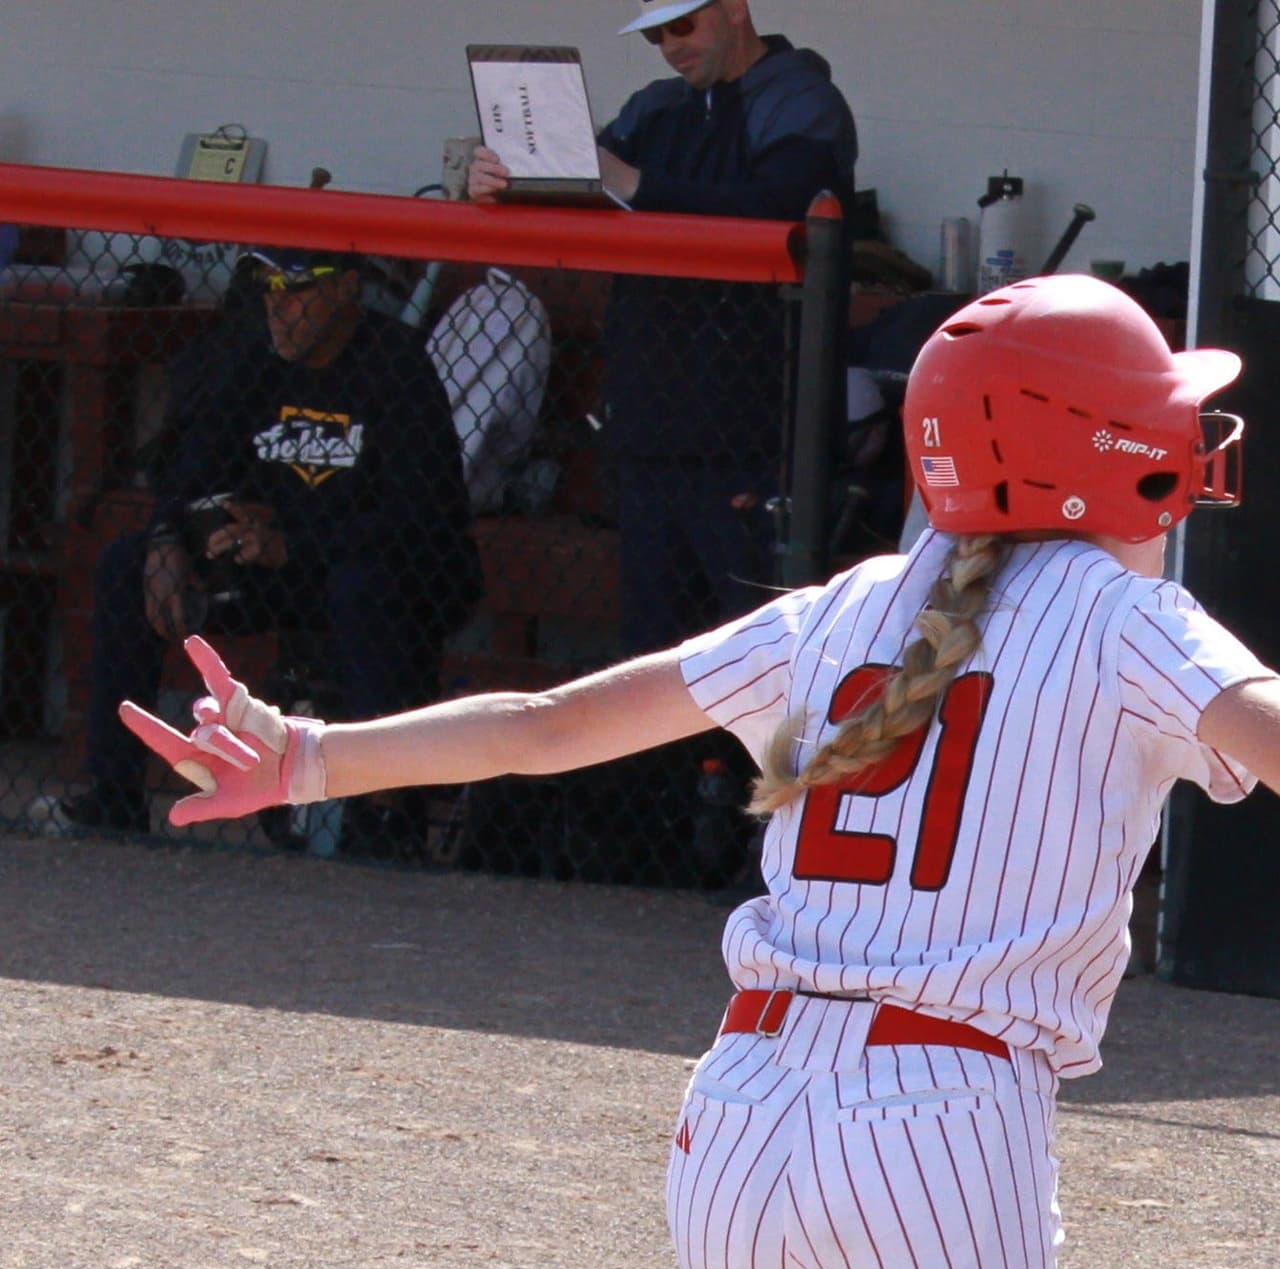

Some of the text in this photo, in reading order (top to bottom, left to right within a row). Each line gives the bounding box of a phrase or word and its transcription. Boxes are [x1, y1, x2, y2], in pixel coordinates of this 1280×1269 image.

[922, 417, 941, 447] 21
[1114, 438, 1167, 461] RIP-IT
[792, 662, 995, 893] 21
